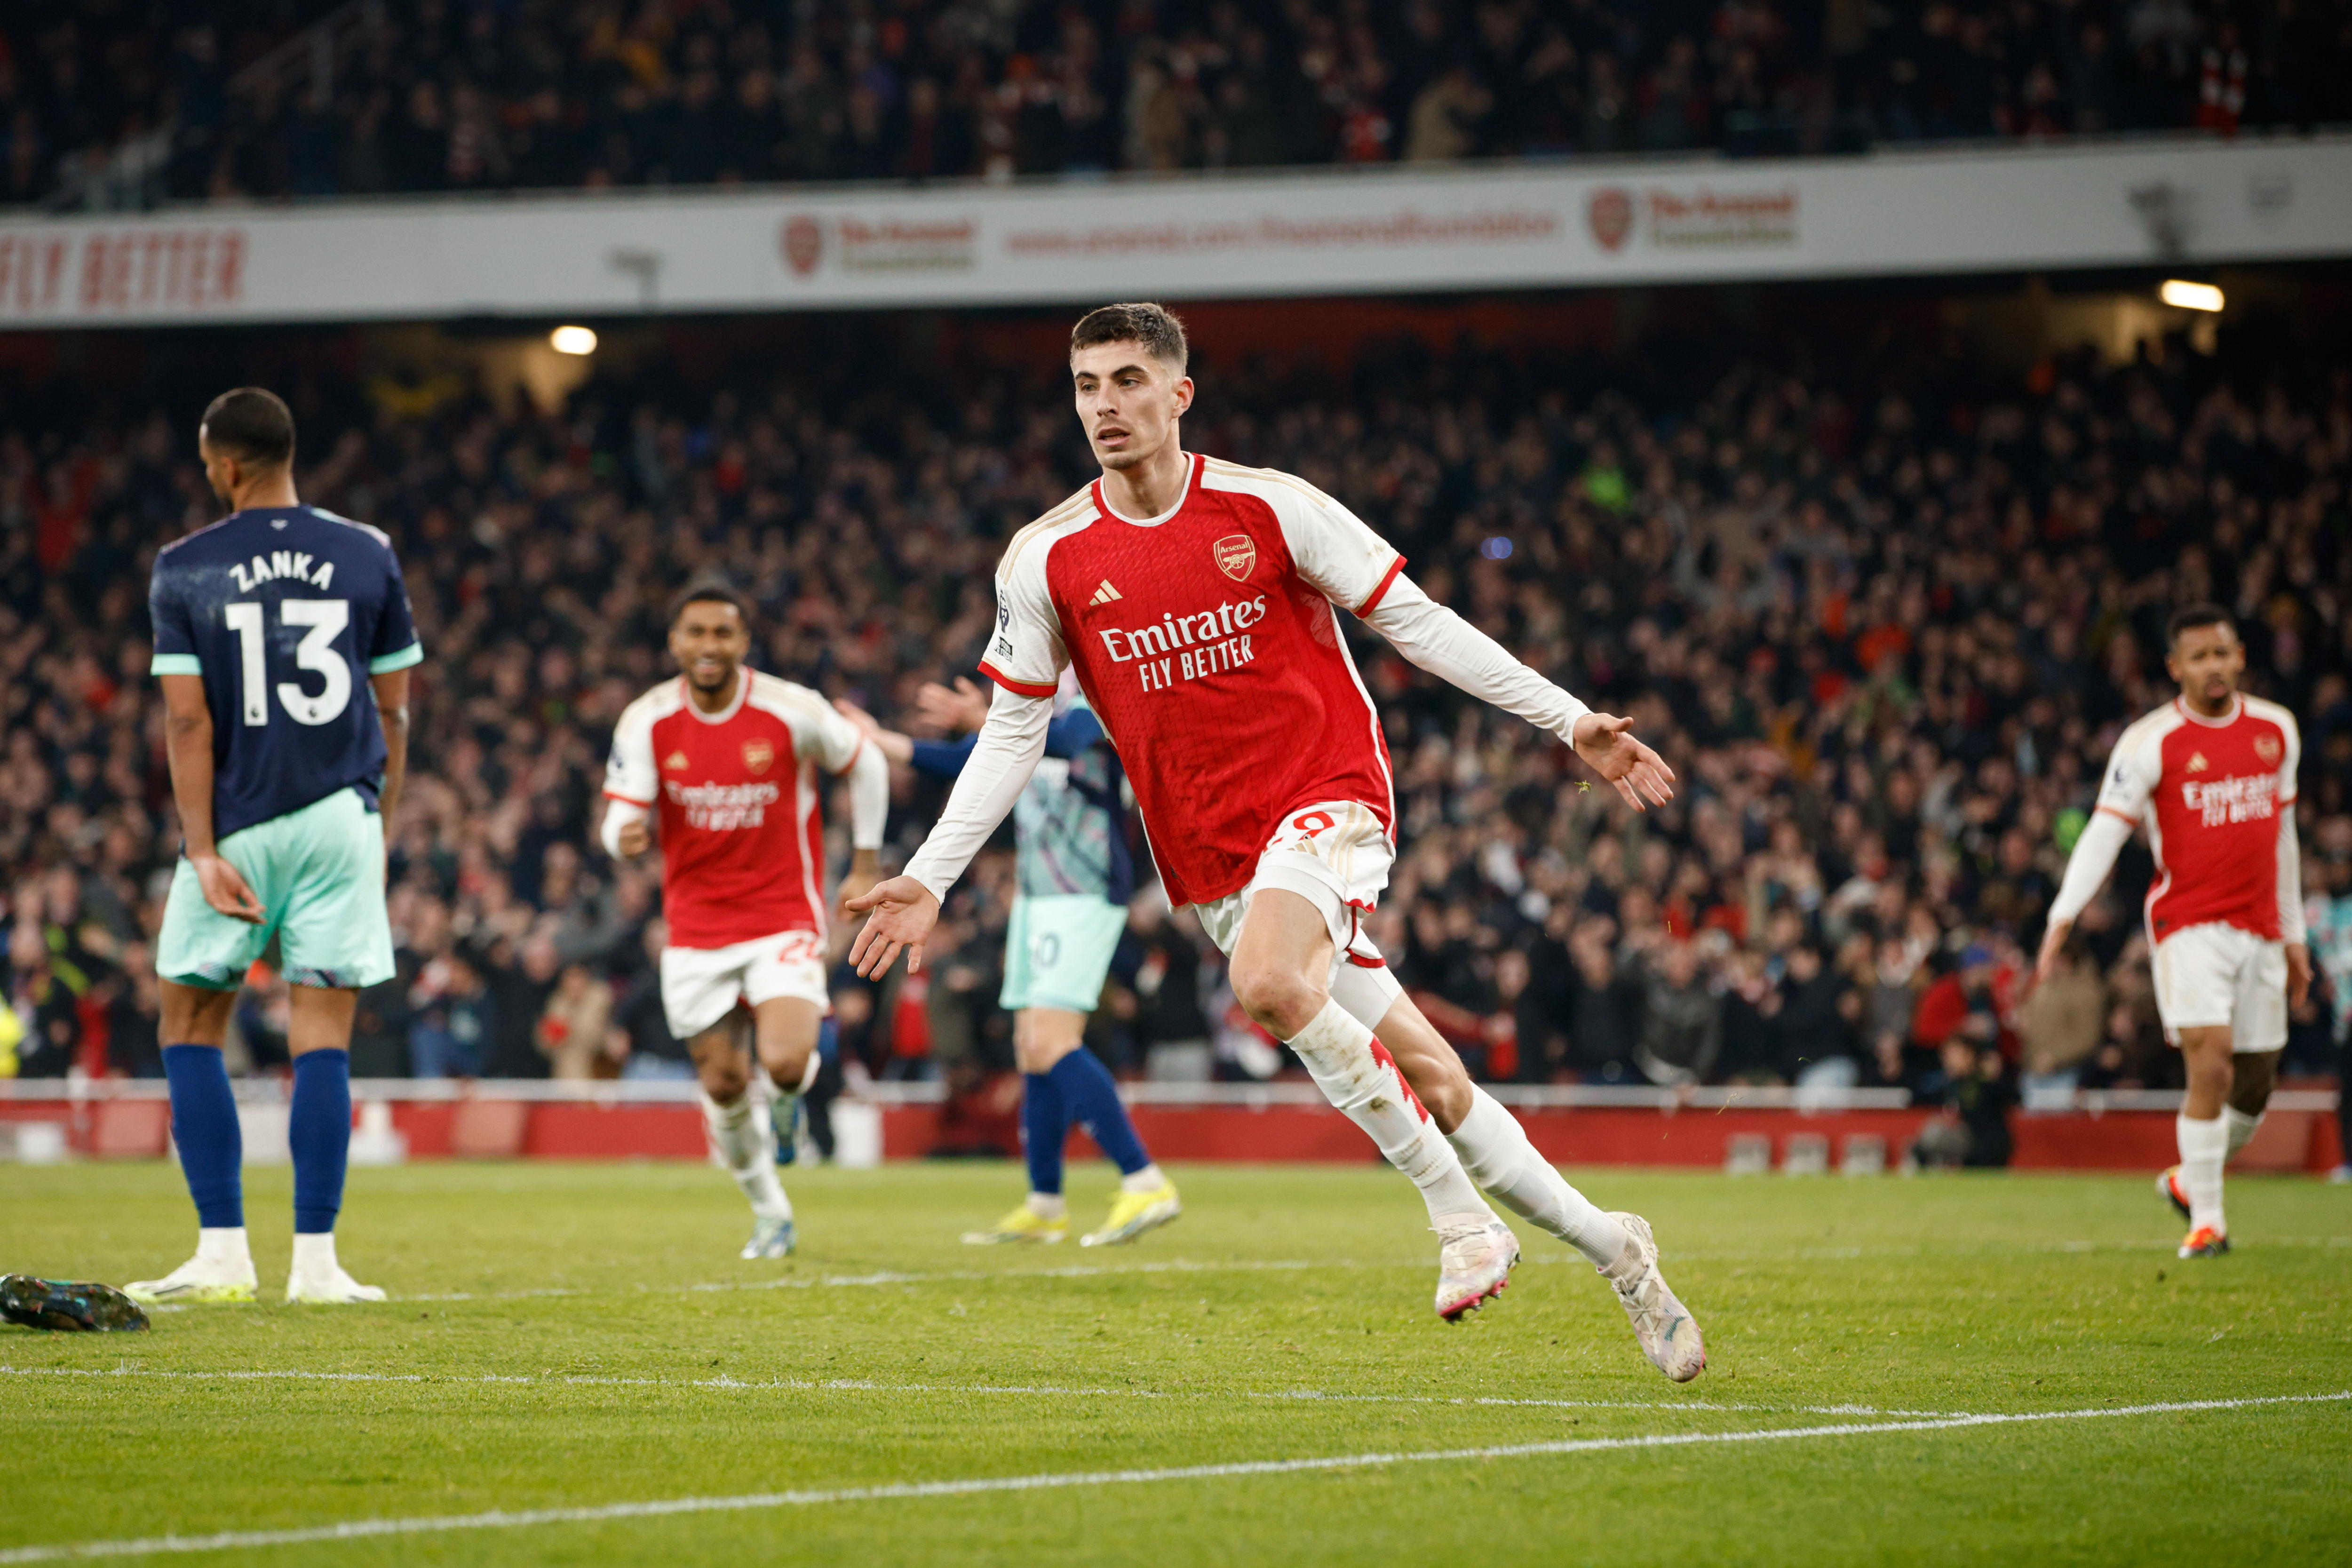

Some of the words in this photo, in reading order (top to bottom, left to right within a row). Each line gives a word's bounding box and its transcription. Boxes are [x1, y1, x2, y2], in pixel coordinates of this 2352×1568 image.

[80, 230, 249, 307] BETTER
[229, 550, 334, 593] ZANKA
[1220, 541, 1248, 554] Arsenal
[1099, 595, 1266, 662] Emirates
[225, 599, 351, 726] 13
[1139, 657, 1172, 692] FLY
[1180, 634, 1254, 681] BETTER
